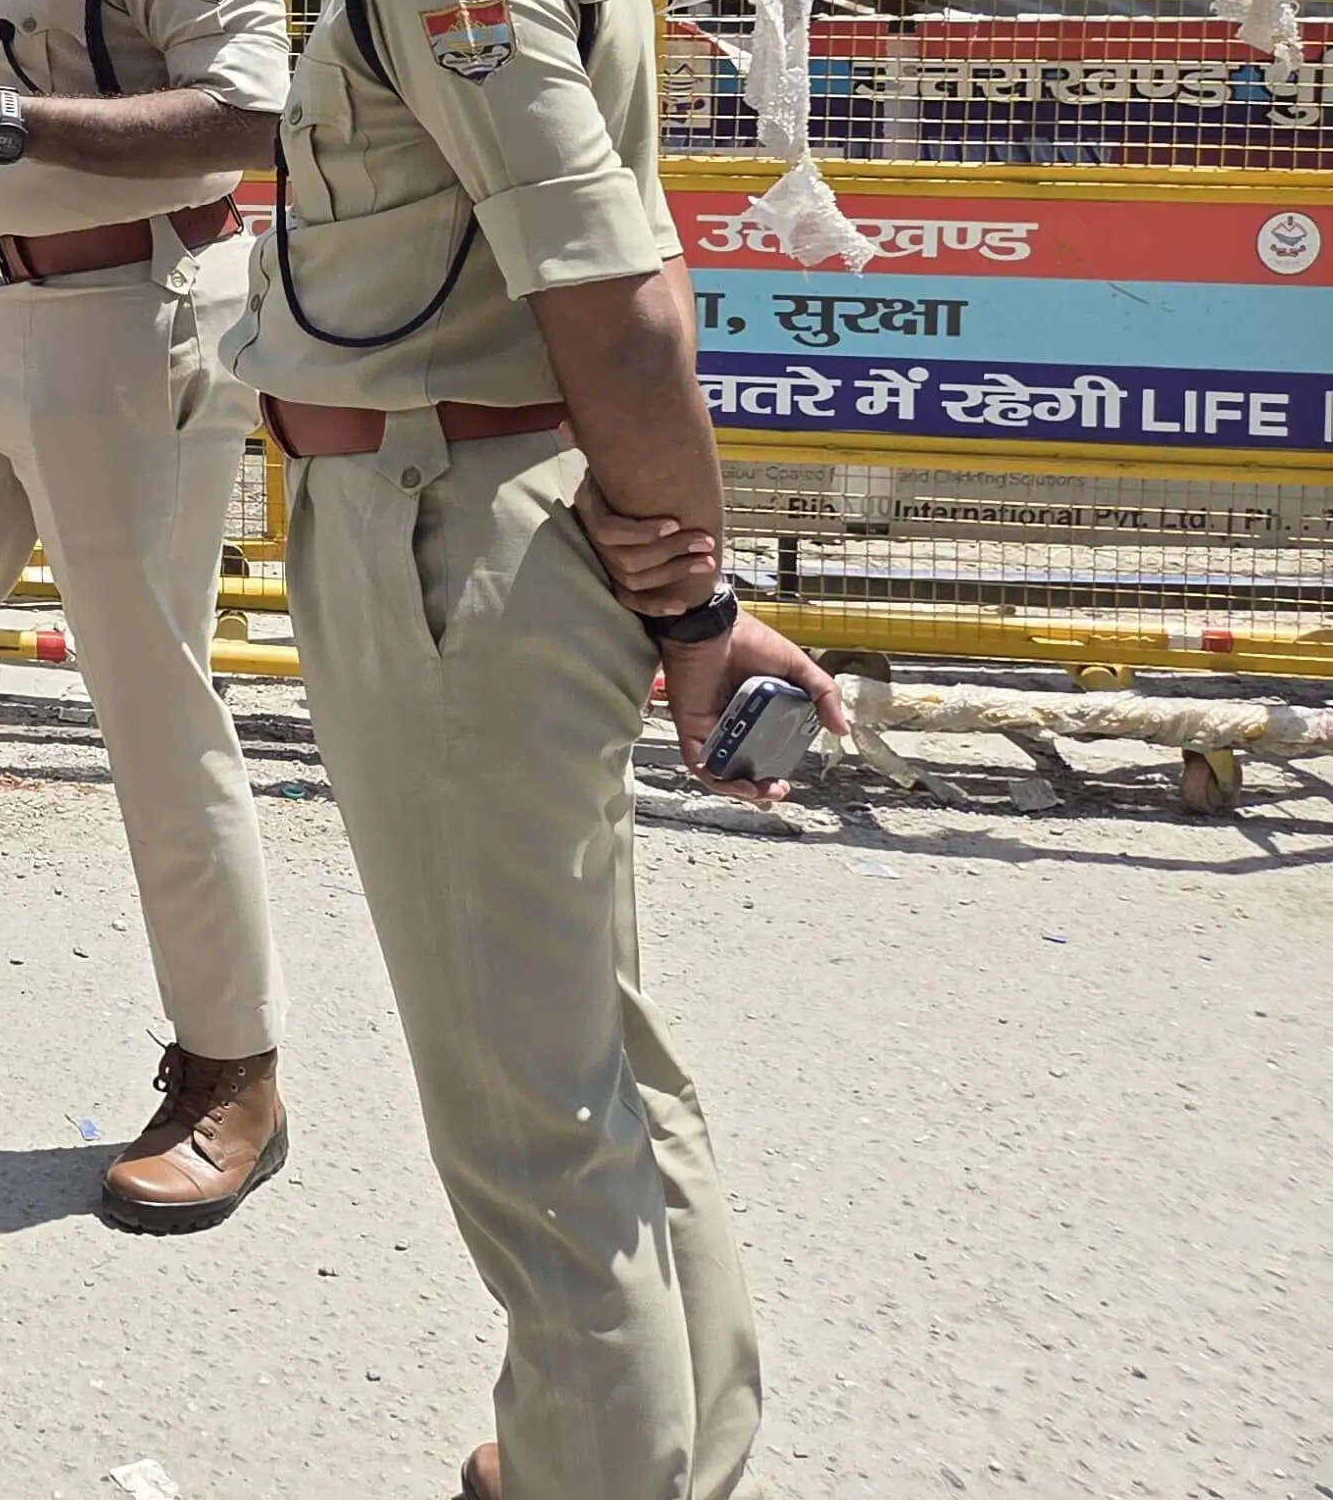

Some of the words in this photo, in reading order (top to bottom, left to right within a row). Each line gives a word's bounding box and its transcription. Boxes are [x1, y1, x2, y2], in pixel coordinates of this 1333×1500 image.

[772, 293, 969, 348] सुरक्षा
[854, 365, 930, 420] में
[939, 373, 1128, 428] रहेगी
[1141, 388, 1290, 437] LIFE
[894, 500, 1084, 527] International
